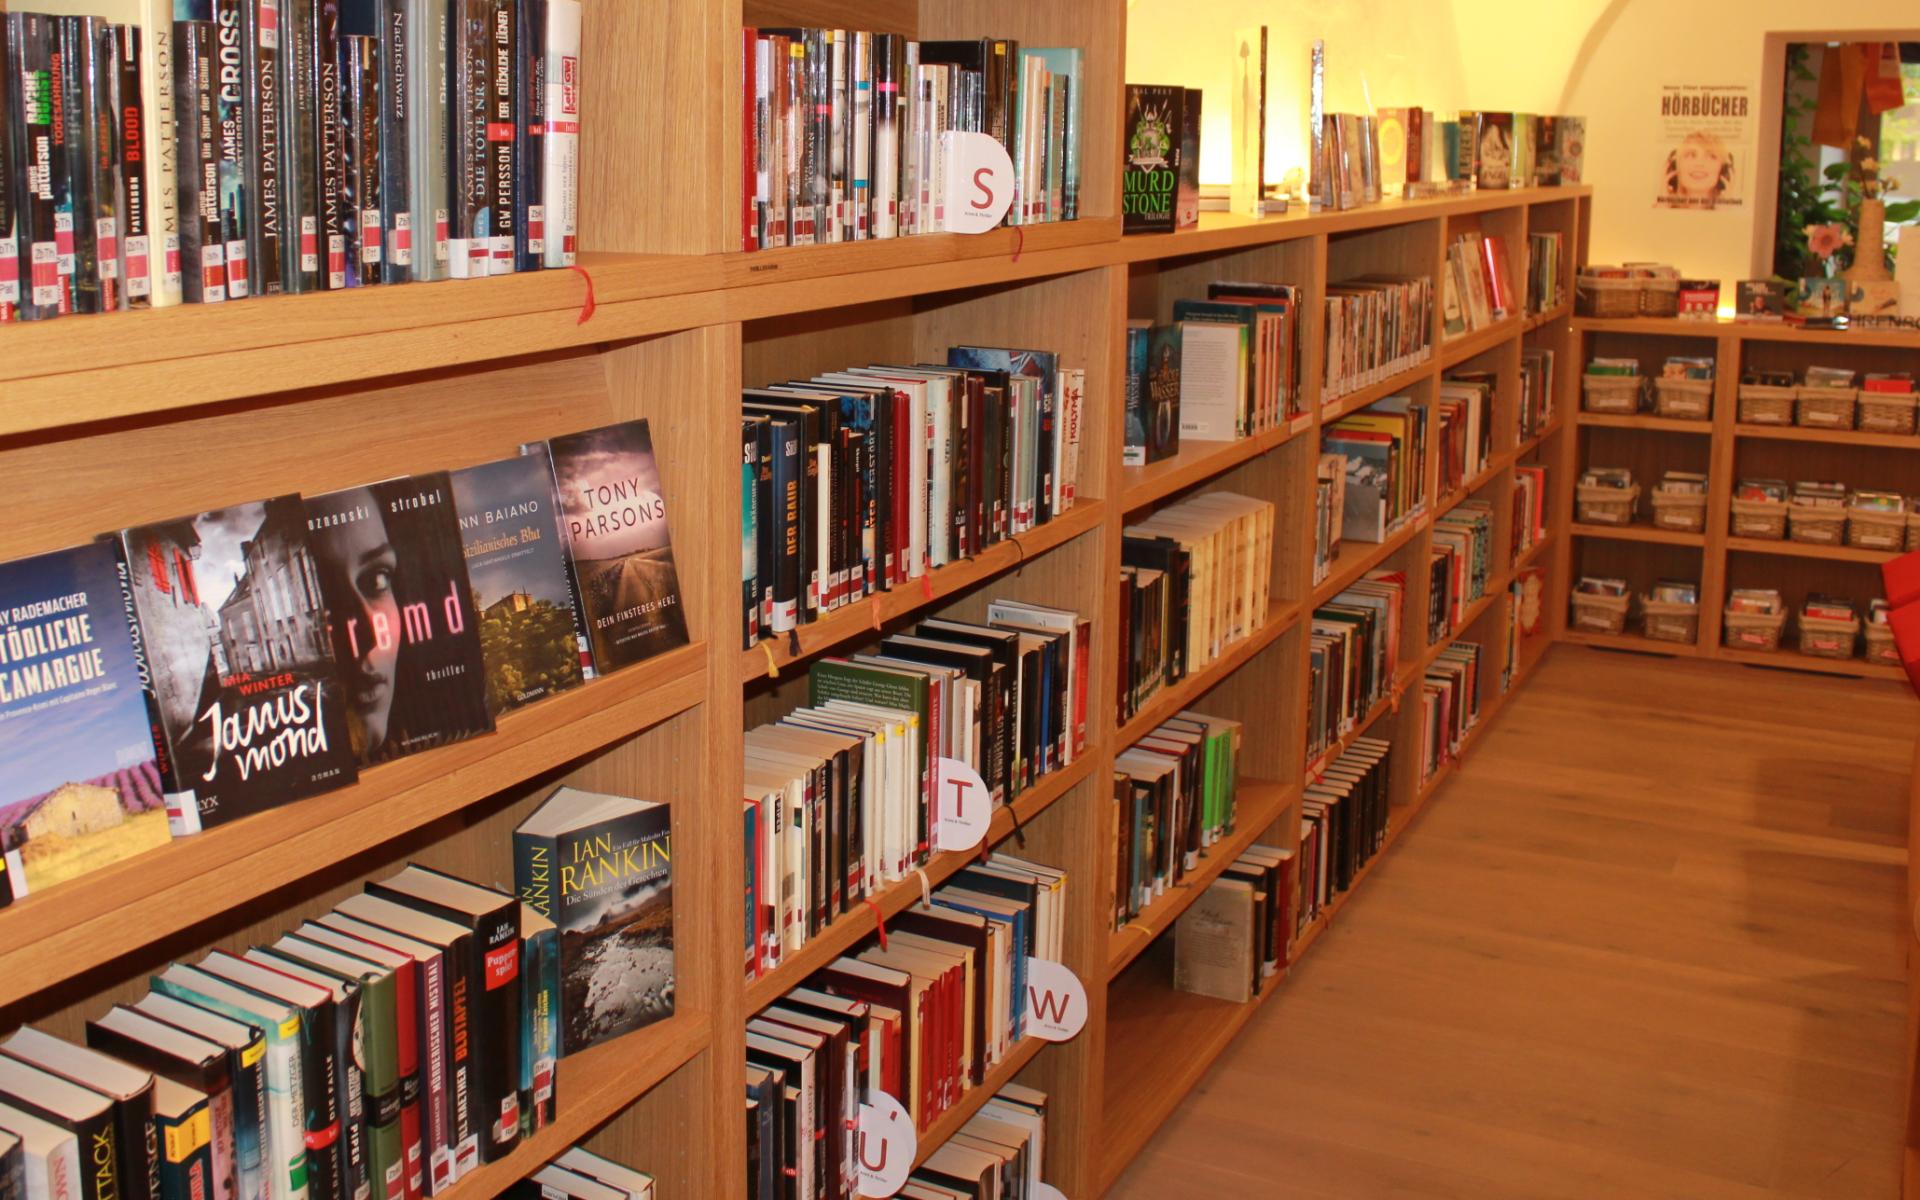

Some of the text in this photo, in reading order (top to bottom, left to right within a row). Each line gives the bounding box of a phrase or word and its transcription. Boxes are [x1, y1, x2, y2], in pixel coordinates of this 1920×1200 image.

[219, 9, 242, 102] CROSS
[393, 12, 404, 119] Nachtschwarz
[475, 57, 486, 75] 12
[52, 53, 63, 145] TODESAHNUNG
[199, 57, 213, 159] Die Spur der Schuld
[475, 81, 486, 111] NR.
[499, 101, 509, 118] DER
[1661, 91, 1748, 117] HÖRBÜCHER
[124, 106, 140, 161] BLOOD
[157, 30, 177, 234] MES PATTERSON
[222, 119, 236, 163] JAMES
[261, 59, 277, 239] JAMES PATTERSON
[323, 62, 338, 235] JAMES PATTERSON
[475, 114, 486, 150] TOTE
[36, 136, 54, 200] patterson
[475, 165, 486, 196] DIE
[498, 145, 511, 228] GW PERSSON
[971, 167, 994, 209] S
[1123, 170, 1175, 193] MURD
[206, 162, 220, 223] patterson
[1123, 193, 1172, 215] STONE
[1069, 387, 1079, 440] KOLYMA
[308, 489, 442, 532] oznanski strobel
[458, 500, 538, 530] NN BAIANO
[583, 478, 640, 509] TONY
[520, 526, 541, 543] Blut
[571, 499, 665, 542] PARSONS
[0, 592, 88, 626] AY RADEMACHER
[346, 580, 464, 659] remd
[597, 594, 676, 629] DEIN FINSTERES HERZ
[0, 613, 94, 664] TÖDLICHE
[0, 648, 106, 703] CAMARGUE
[222, 672, 251, 688] MIA
[239, 672, 295, 696] WINTER
[426, 663, 466, 682] thriller
[199, 682, 311, 783] Janus
[235, 682, 328, 781] mond
[947, 779, 973, 817] T
[561, 836, 672, 896] RANKIN
[573, 832, 612, 864] IAN
[531, 846, 549, 919] ANKIN
[566, 894, 581, 907] Die
[583, 885, 613, 899] Sünden
[428, 961, 442, 1093] MÖRDERISCHER MISTRAL
[453, 976, 468, 1063] BLUTAPFEL
[1029, 986, 1070, 1024] W
[324, 1053, 336, 1121] DIE FALLE
[456, 1067, 468, 1120] RAETHER
[92, 1125, 114, 1200] TTACK
[350, 1122, 360, 1166] PIPER
[860, 1131, 887, 1172] U
